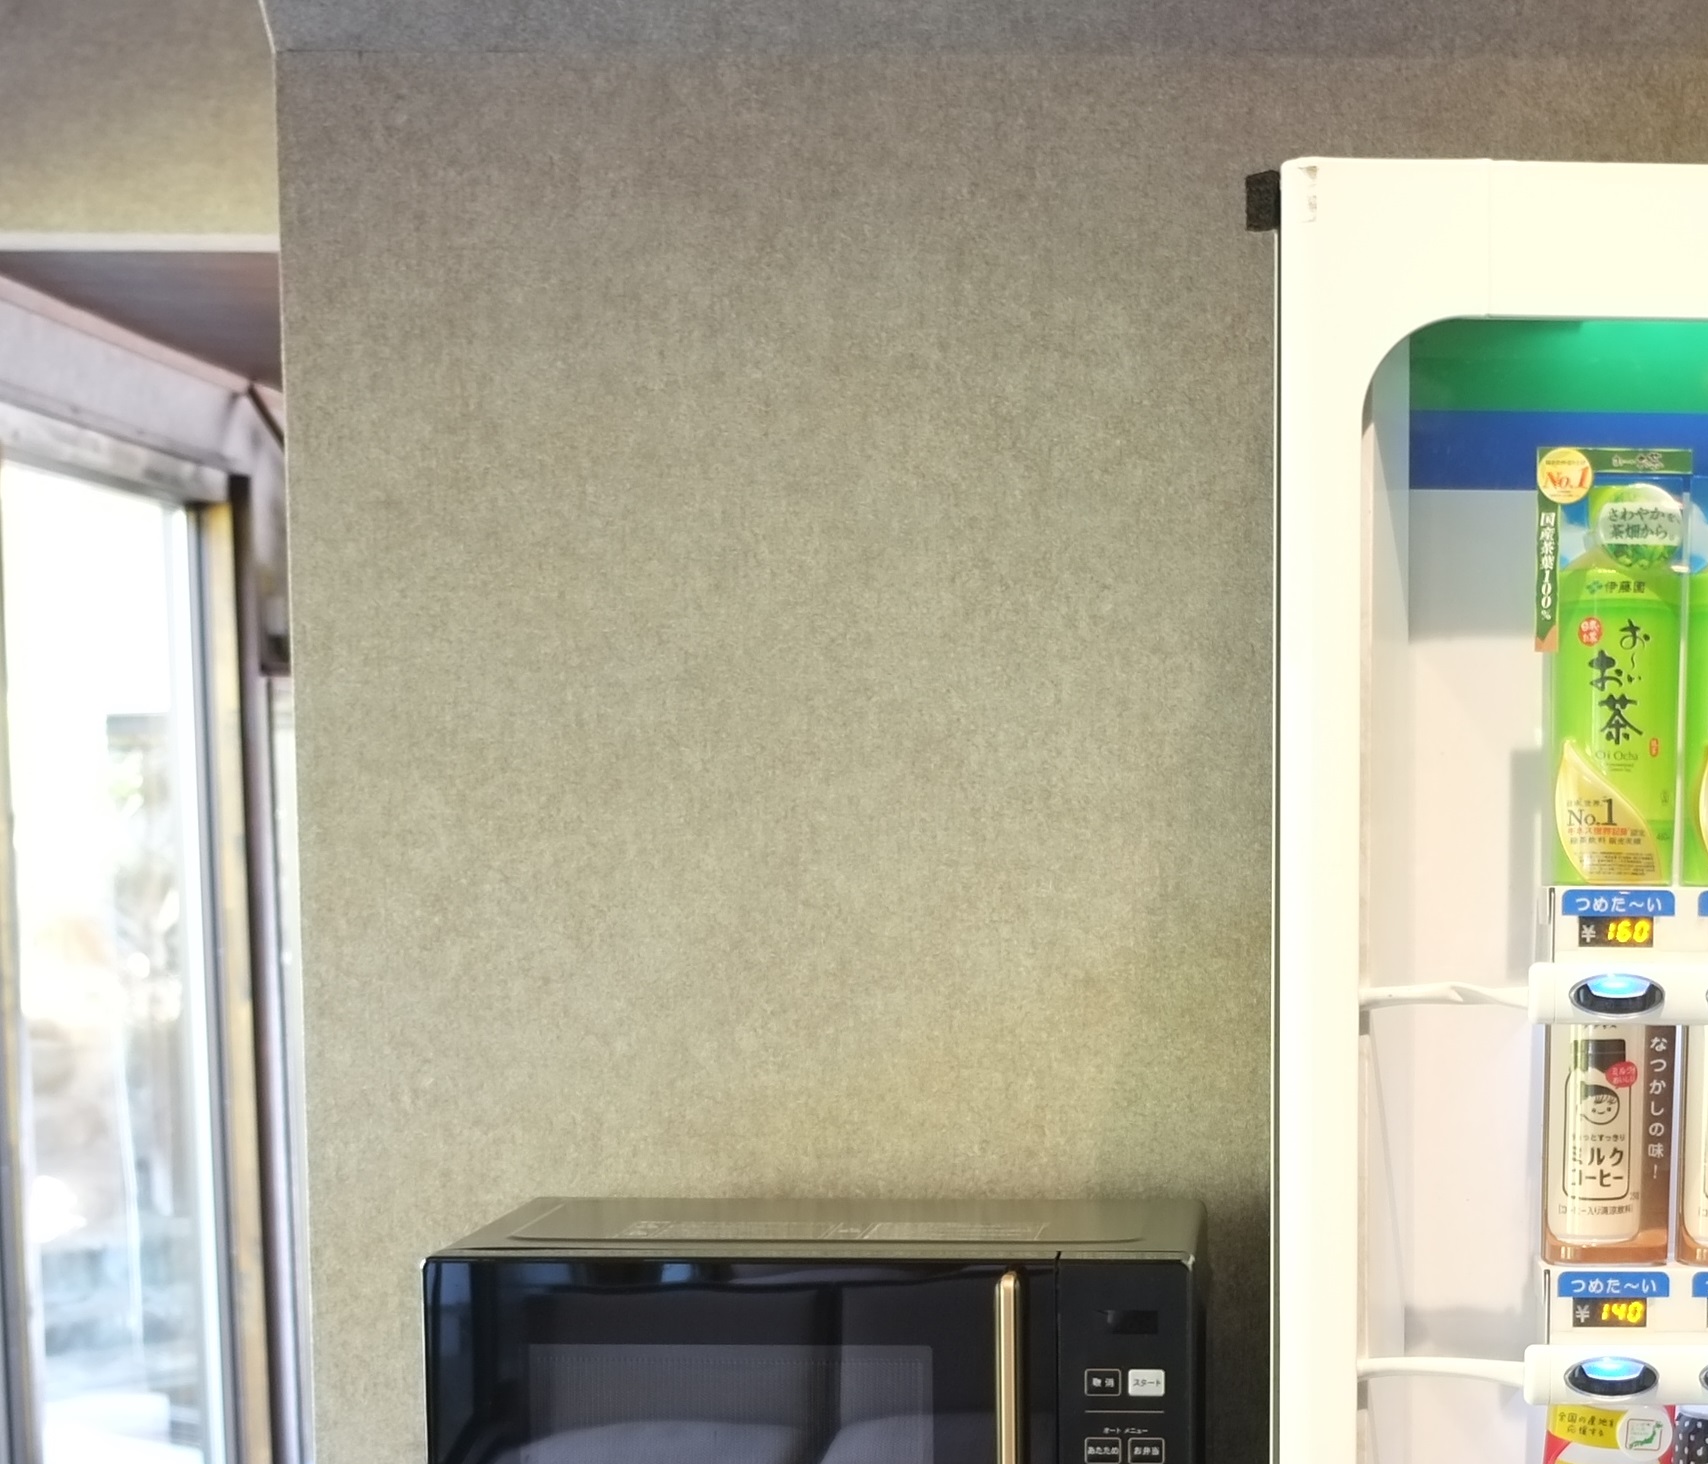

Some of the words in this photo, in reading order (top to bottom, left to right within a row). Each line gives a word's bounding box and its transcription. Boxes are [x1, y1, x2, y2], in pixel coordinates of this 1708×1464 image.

[1604, 580, 1646, 594] 伊藤園
[1567, 799, 1617, 826] No.1
[1132, 1378, 1161, 1388] スタート
[1133, 1446, 1160, 1456] お弁当
